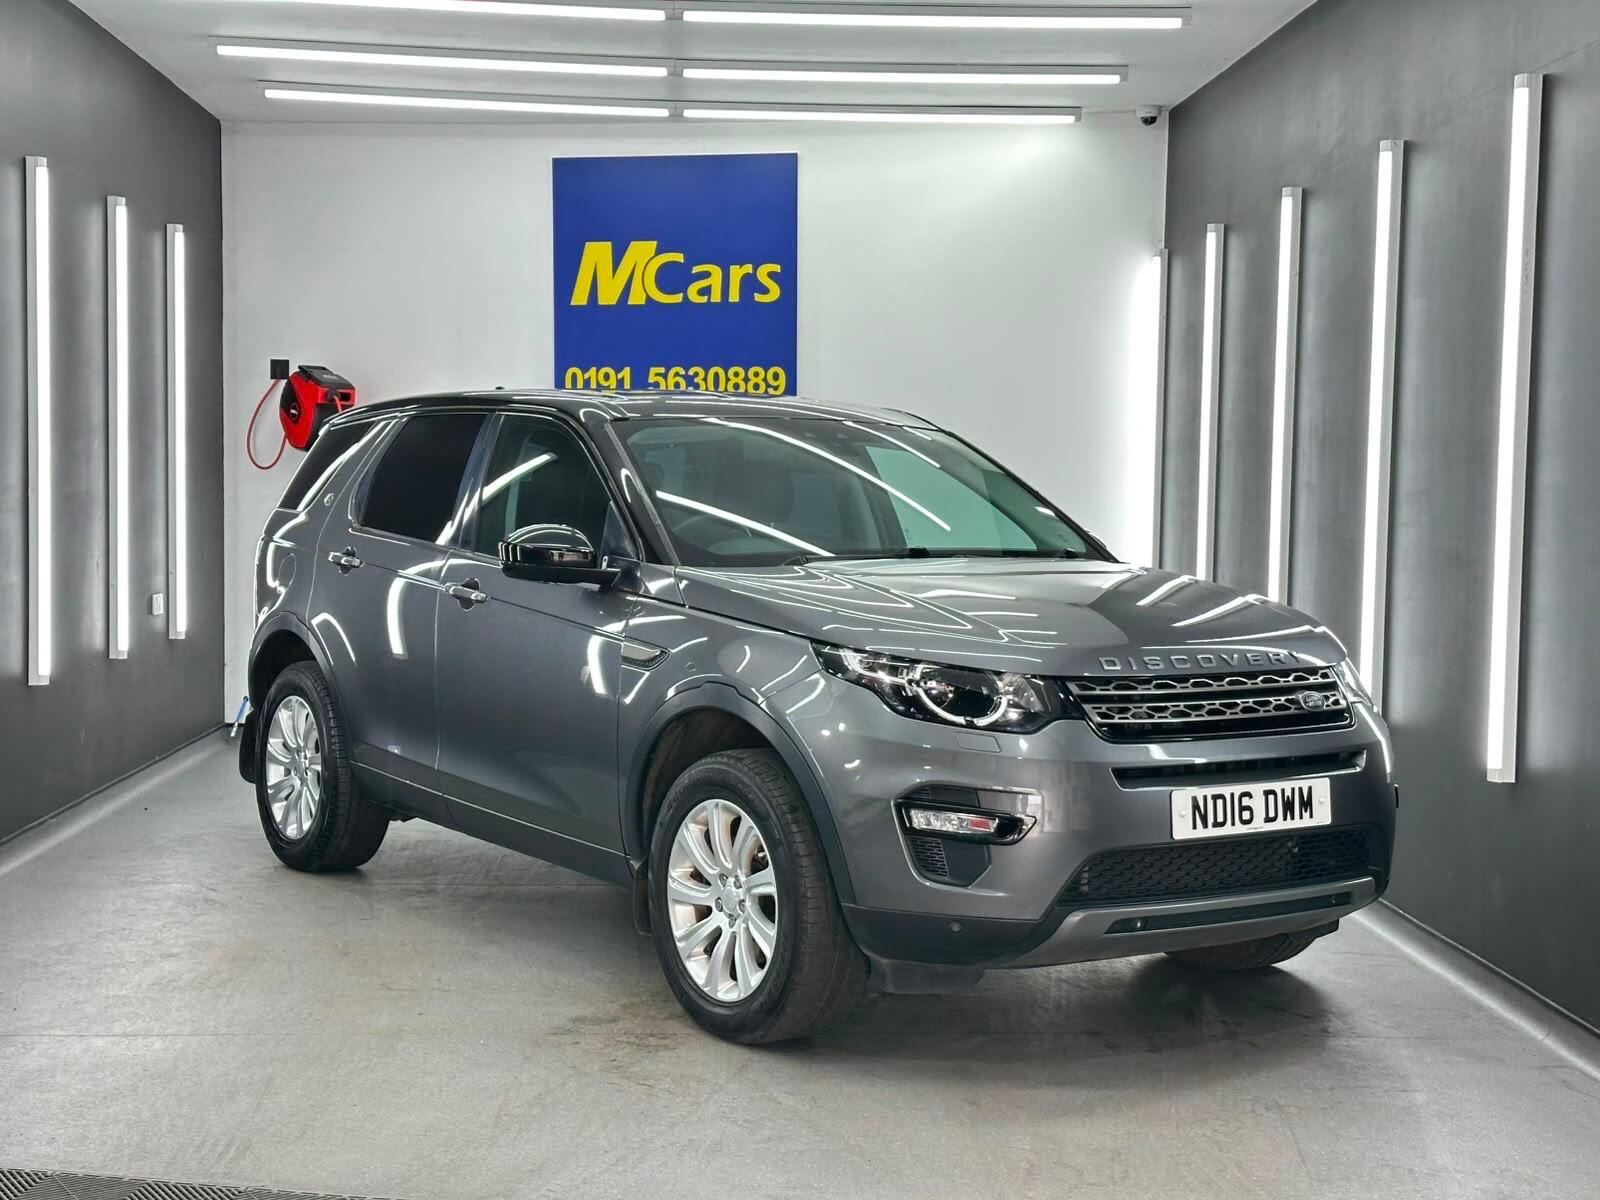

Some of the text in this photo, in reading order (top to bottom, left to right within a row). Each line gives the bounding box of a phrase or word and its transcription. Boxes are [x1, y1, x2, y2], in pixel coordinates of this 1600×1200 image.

[565, 366, 786, 396] 0191 5630889
[1099, 651, 1301, 671] DISCOVERY
[1191, 785, 1314, 830] ND16 DWM
